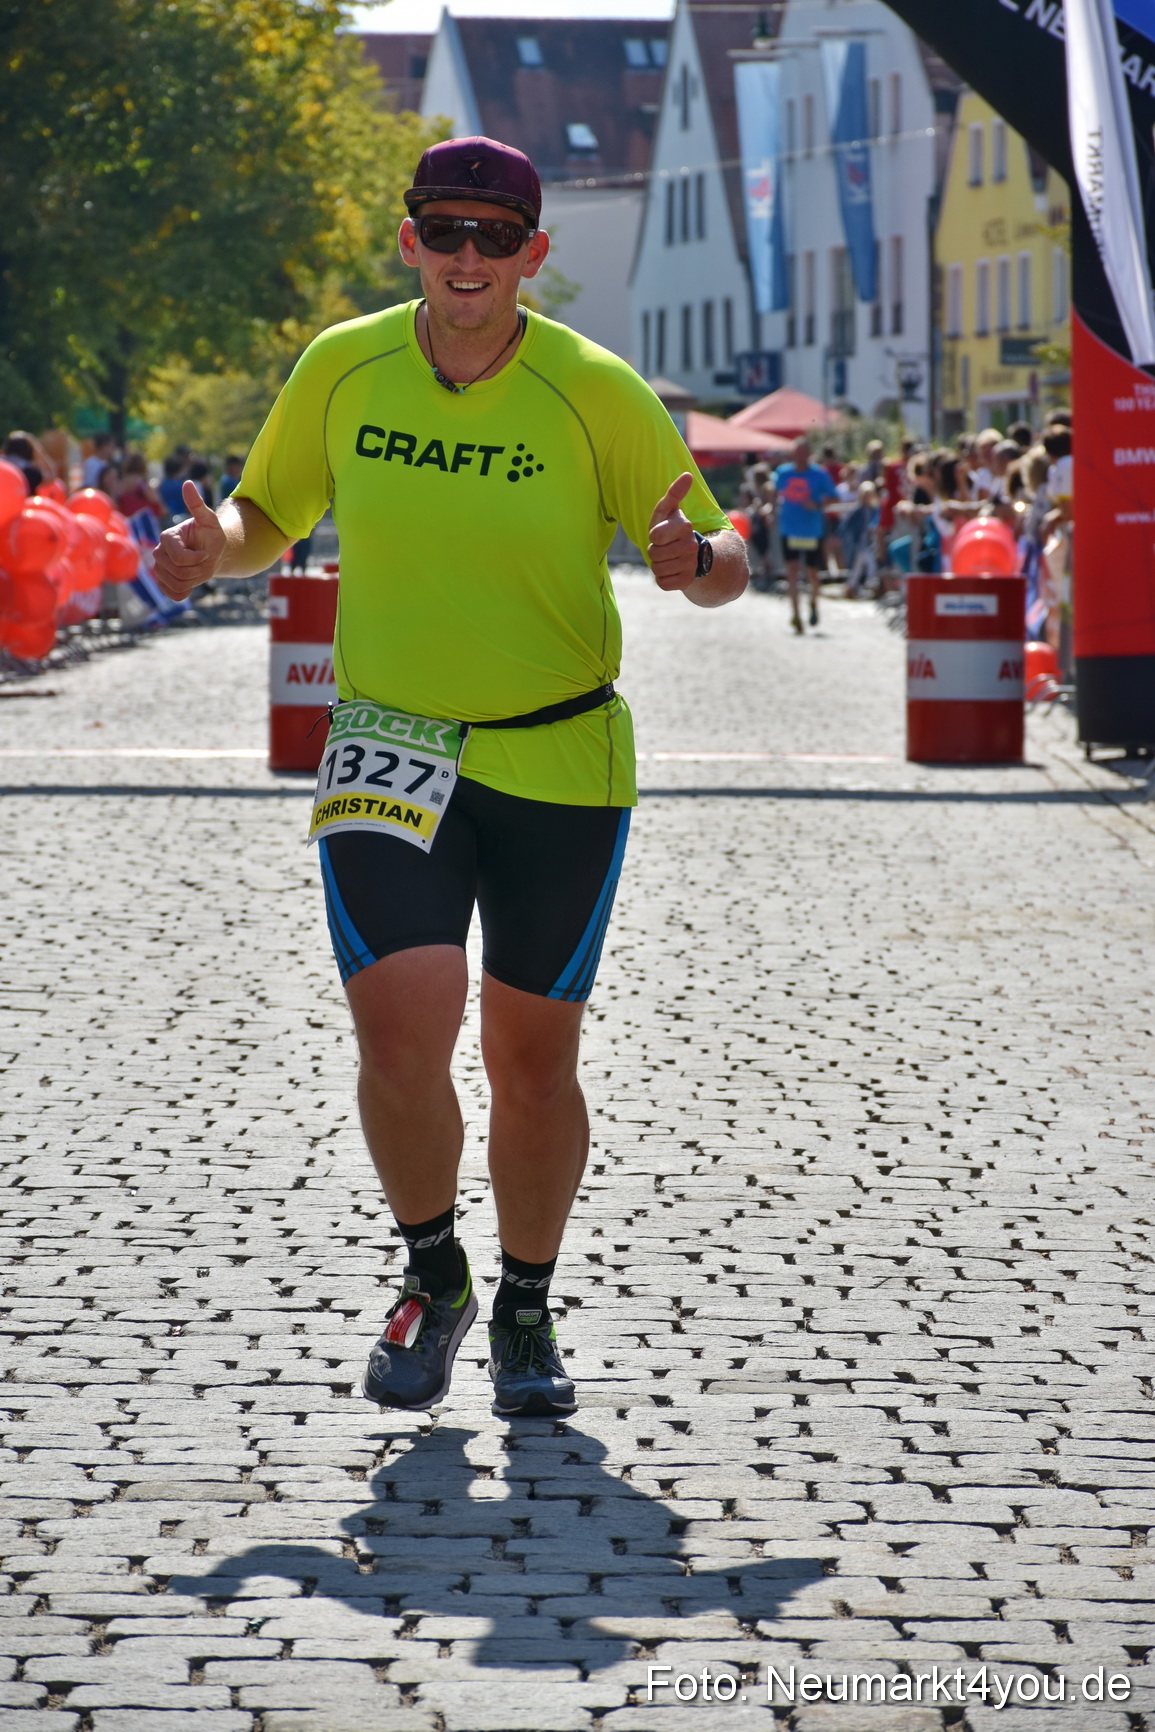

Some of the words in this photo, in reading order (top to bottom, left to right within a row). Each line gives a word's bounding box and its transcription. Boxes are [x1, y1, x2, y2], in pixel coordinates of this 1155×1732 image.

[1137, 396, 1155, 411] YE
[355, 424, 506, 477] CRAFT
[1115, 511, 1155, 524] www.
[331, 706, 453, 753] BOCK
[325, 743, 437, 795] 1327
[440, 770, 450, 779] D
[315, 797, 423, 828] CHRISTIAN
